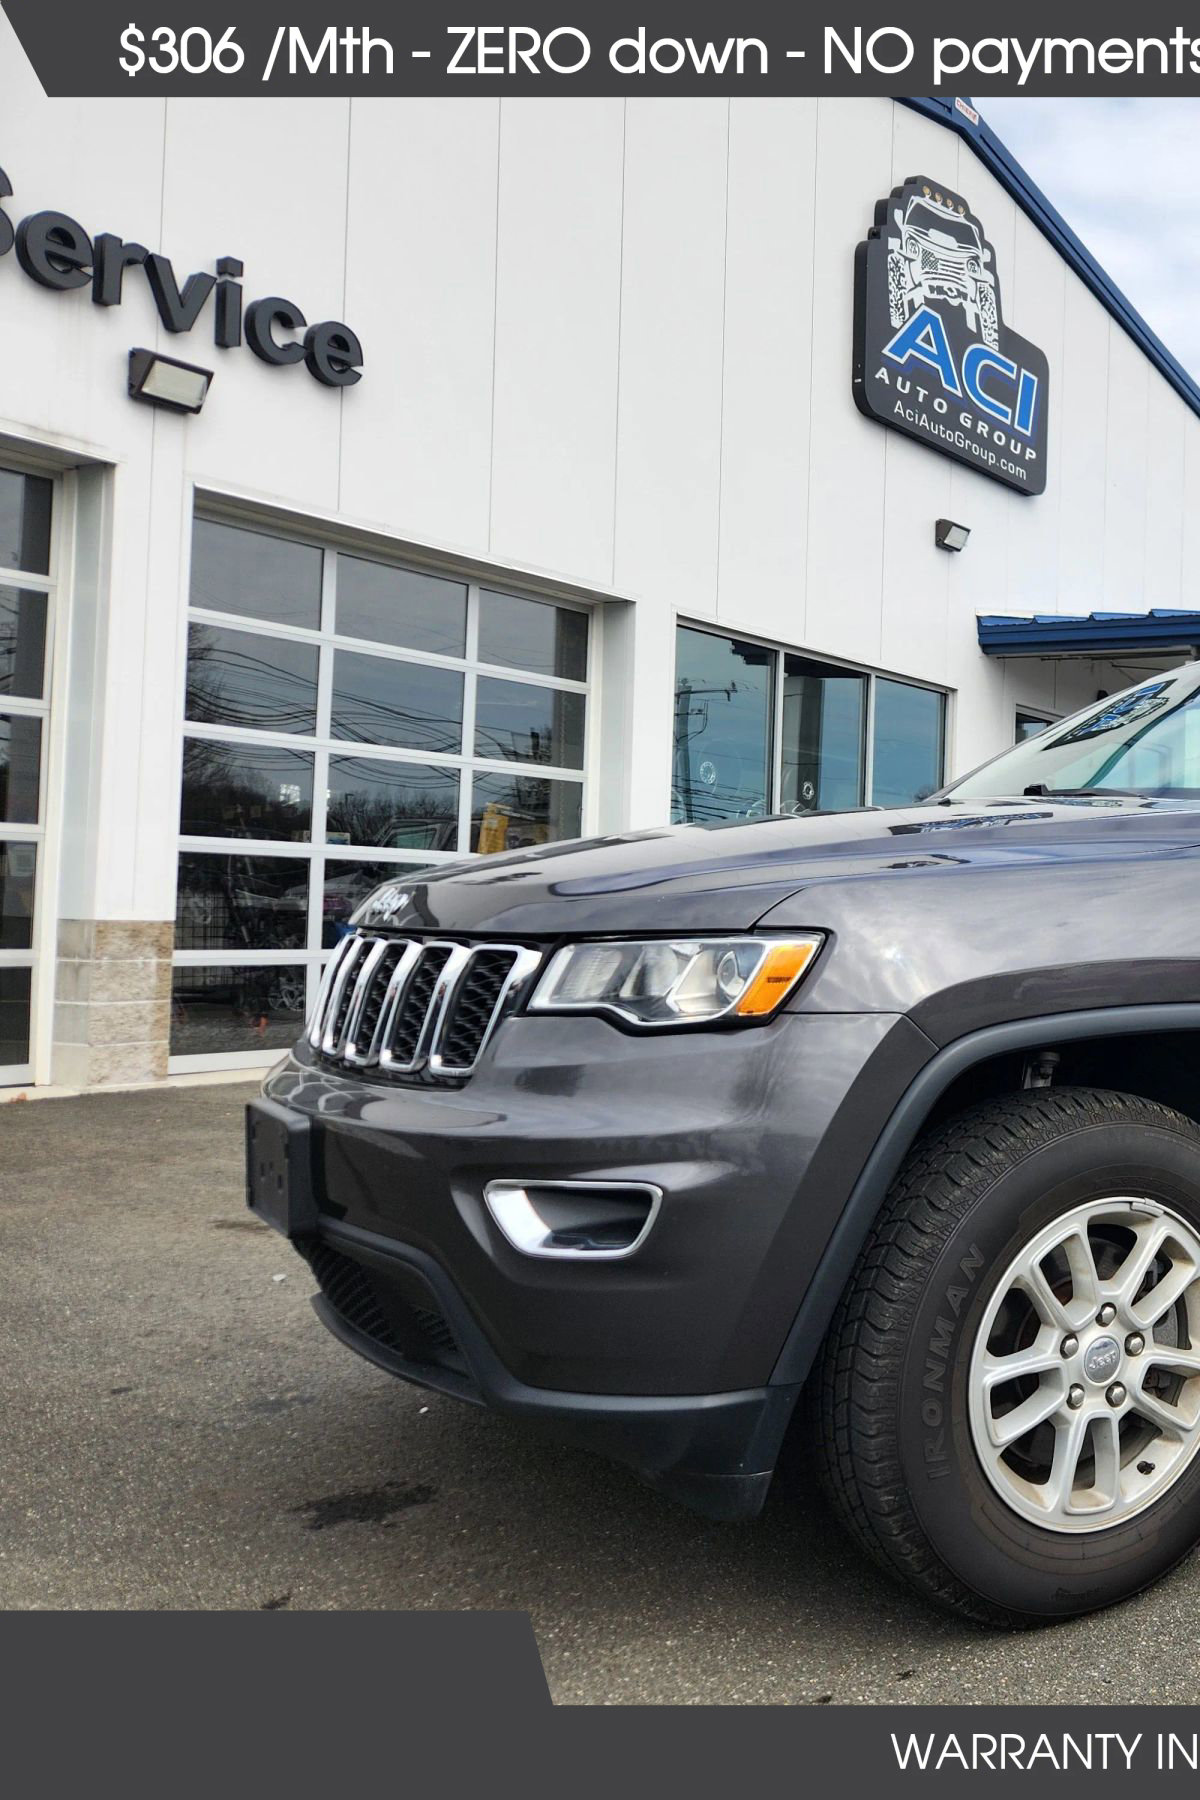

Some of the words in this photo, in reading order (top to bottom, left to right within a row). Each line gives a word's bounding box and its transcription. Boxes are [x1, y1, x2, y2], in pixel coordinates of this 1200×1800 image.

[0, 166, 364, 388] ervice
[875, 366, 948, 414] AUTO
[959, 411, 1037, 461] GROUP
[881, 303, 1038, 437] ACI
[893, 400, 1027, 480] AciAutoGroup.com
[920, 1240, 986, 1480] IRONMAN
